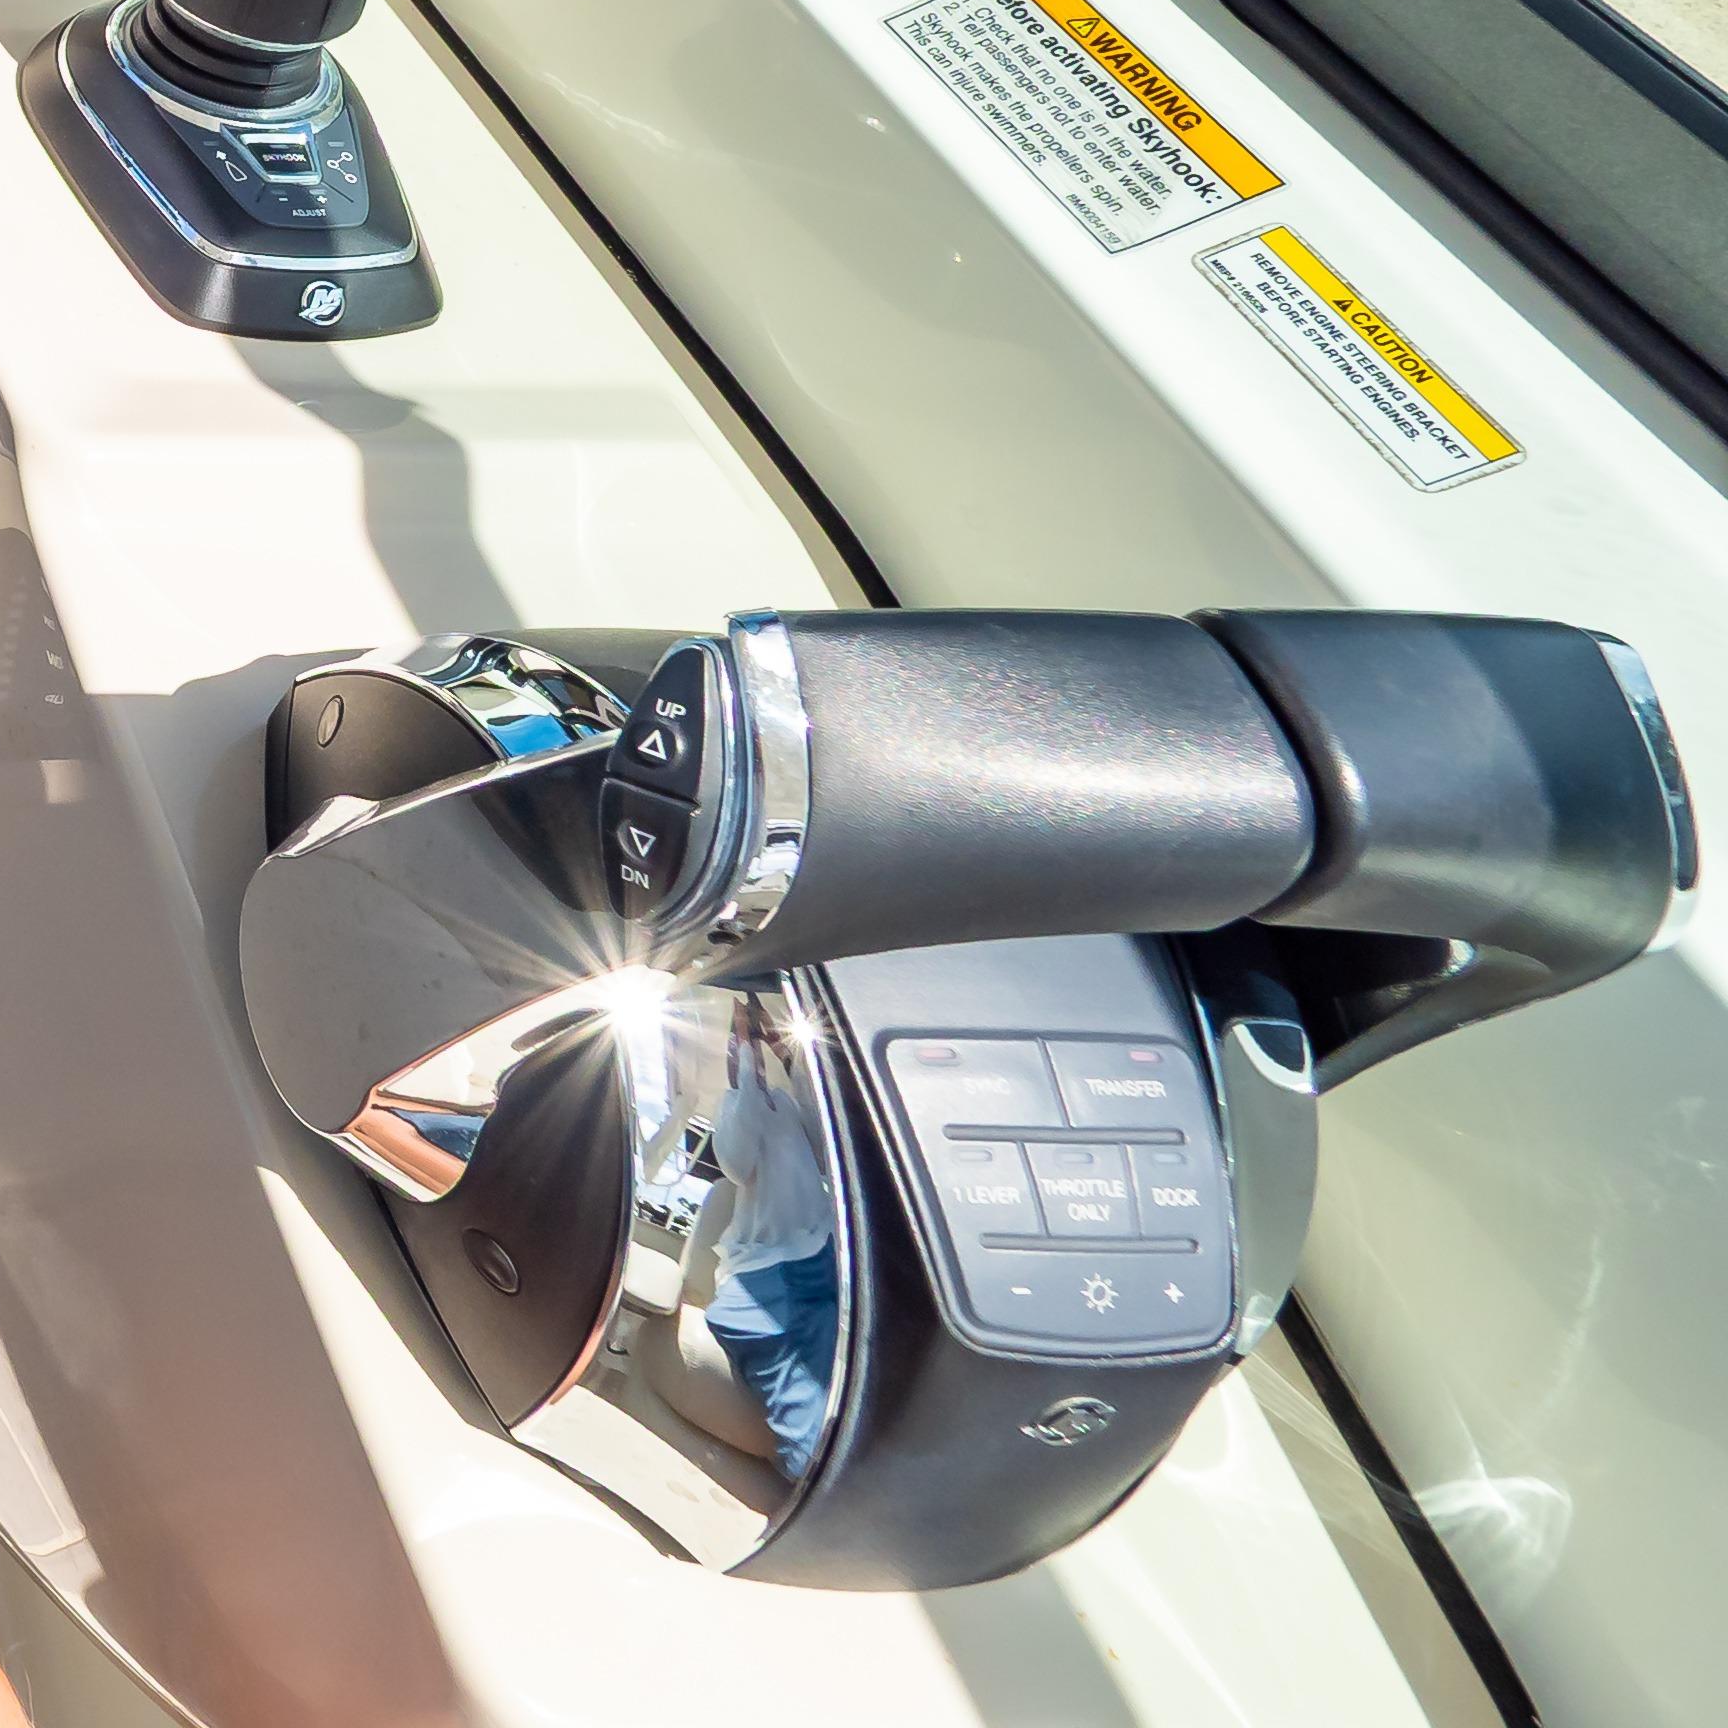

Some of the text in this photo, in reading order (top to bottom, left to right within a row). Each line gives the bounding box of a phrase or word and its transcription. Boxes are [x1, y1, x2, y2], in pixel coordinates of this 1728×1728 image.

[905, 20, 1046, 163] This can injure swimmers.
[914, 13, 1123, 215] Skyhook makes the propellers spin.
[959, 14, 986, 37] Tell
[975, 38, 1050, 104] passengers
[1047, 106, 1074, 126] not
[1069, 126, 1086, 139] to
[1084, 143, 1122, 172] enter
[1119, 175, 1160, 215] water.
[975, 8, 1014, 44] Check
[1011, 44, 1041, 68] that
[1036, 69, 1056, 85] no
[1053, 87, 1081, 109] one
[1078, 110, 1095, 122] is
[1092, 124, 1109, 136] in
[1106, 137, 1132, 158] the
[1130, 160, 1171, 199] water.
[1040, 37, 1132, 118] activating
[1128, 118, 1222, 203] Skyhook:
[1089, 32, 1201, 131] WARNING
[1251, 253, 1469, 458] REMOVE ENGINE STEERING BRACKET
[1257, 282, 1419, 441] BEFORE STARTING ENGINES.
[1351, 313, 1433, 383] CAUTION
[655, 697, 687, 720] UP
[620, 863, 650, 890] DN
[1083, 1077, 1167, 1099] TRANSFER
[966, 1185, 1022, 1205] LEVER
[1040, 1176, 1128, 1200] THROTTLE
[1066, 1203, 1112, 1223] ONLY
[1150, 1186, 1201, 1208] DOCK
